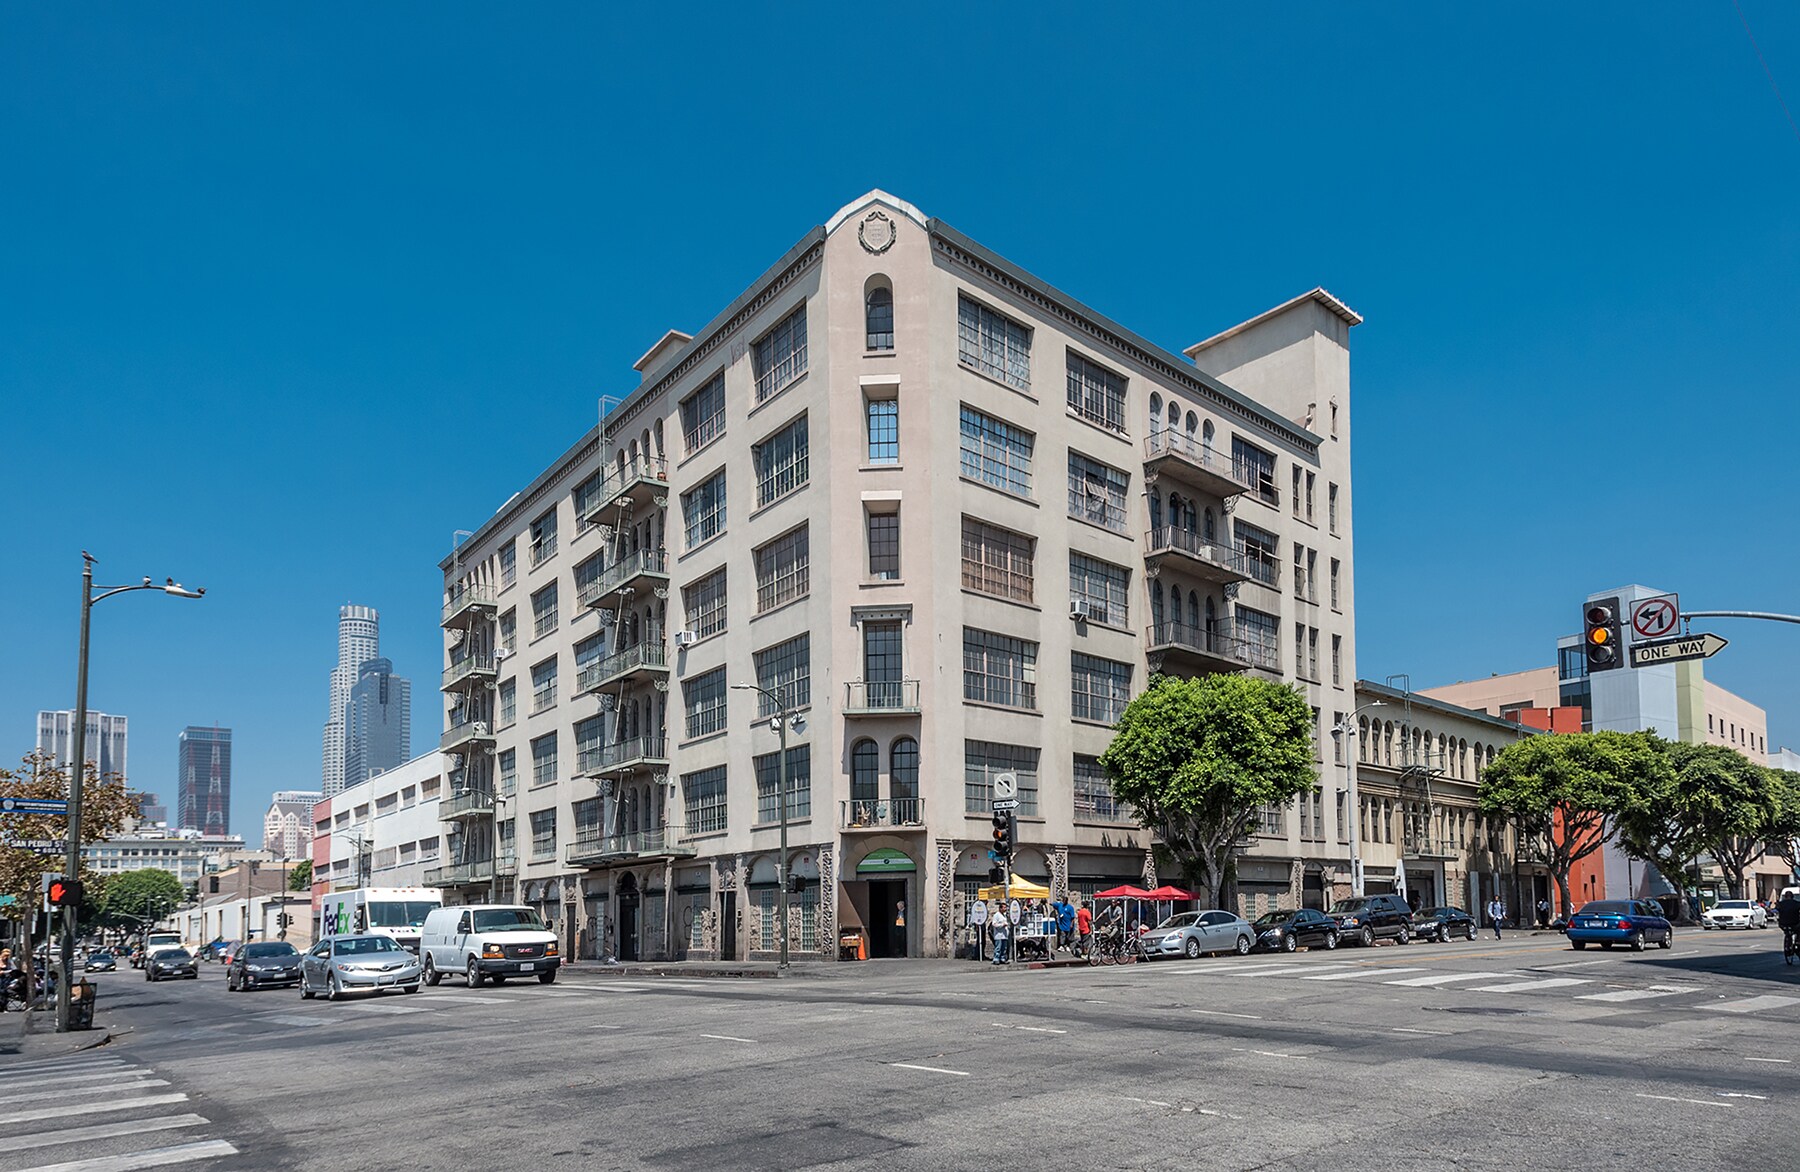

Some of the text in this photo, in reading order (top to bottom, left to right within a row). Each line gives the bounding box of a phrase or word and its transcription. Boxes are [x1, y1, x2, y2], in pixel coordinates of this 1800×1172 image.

[1641, 640, 1706, 660] ONE WAY
[323, 902, 351, 935] FedEx
